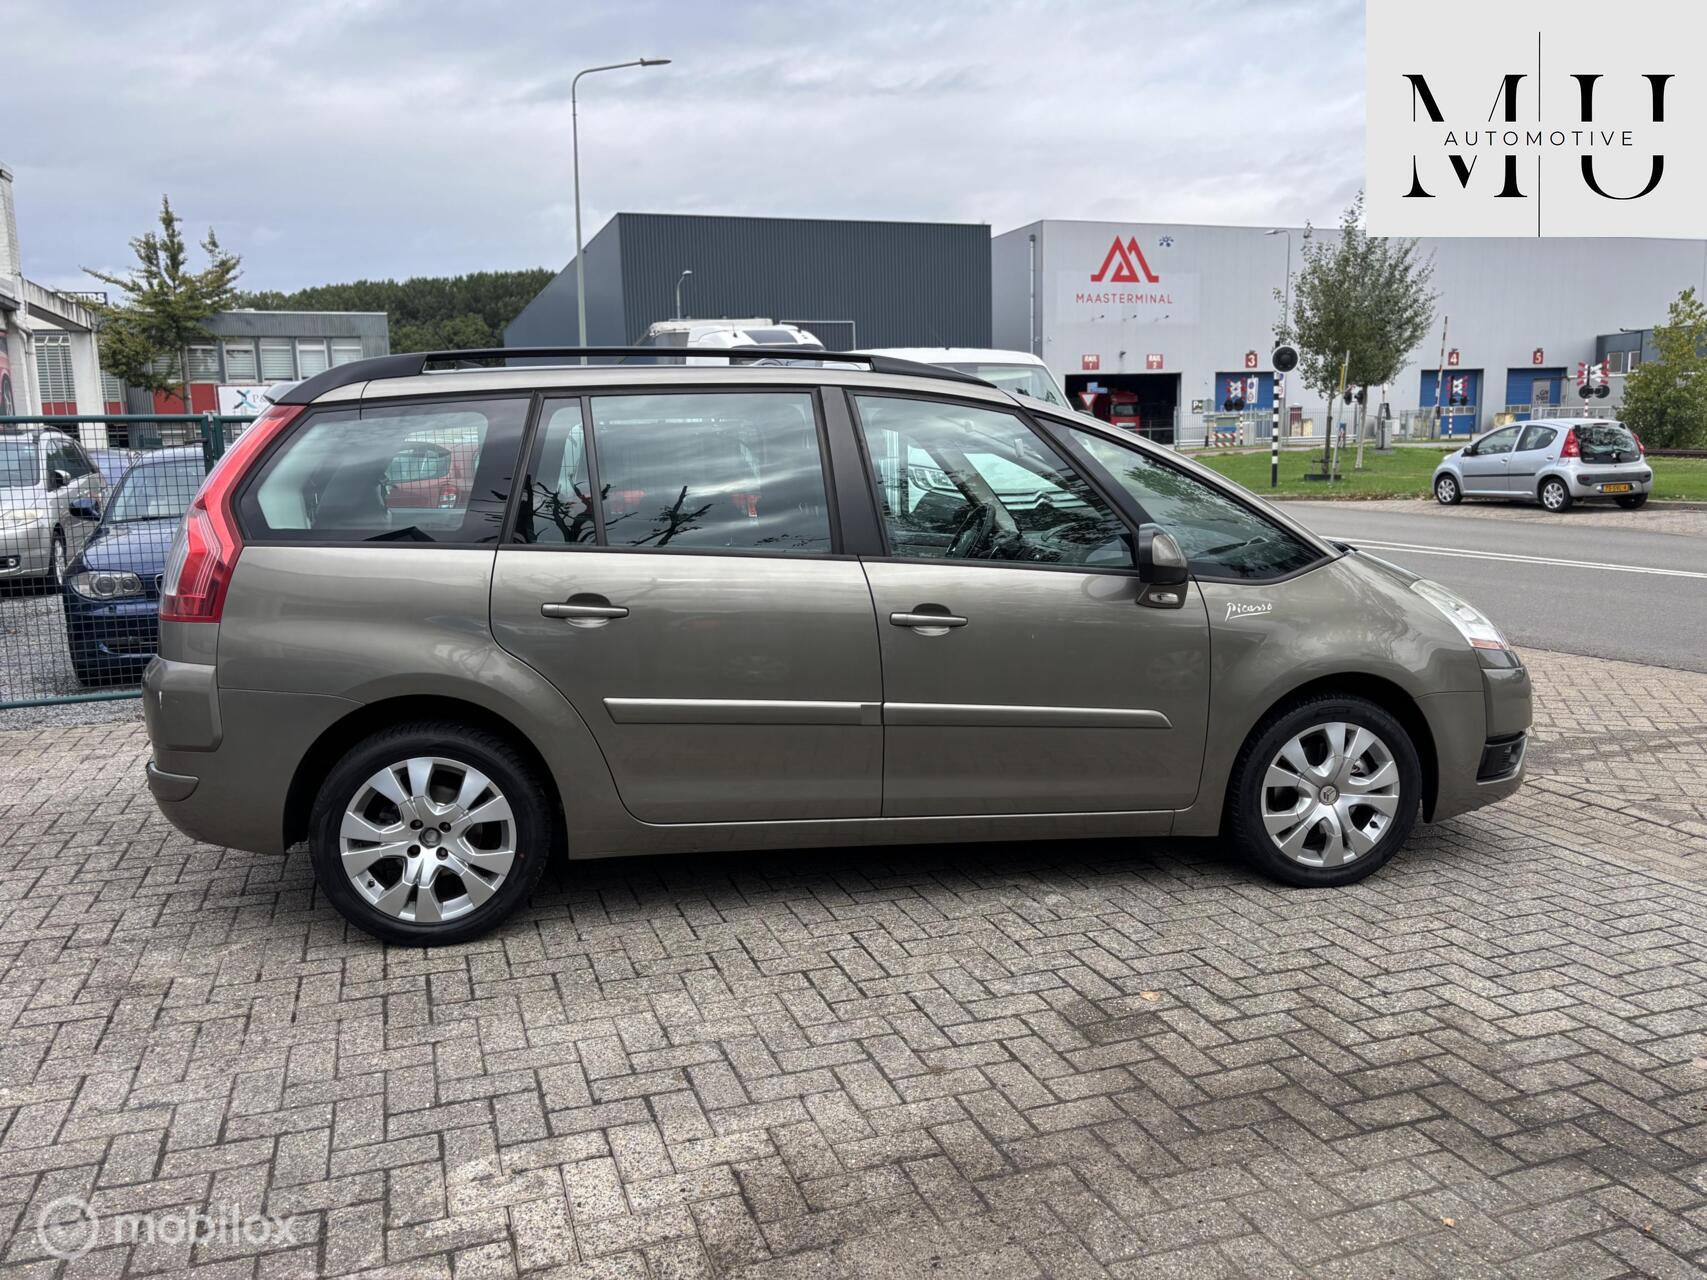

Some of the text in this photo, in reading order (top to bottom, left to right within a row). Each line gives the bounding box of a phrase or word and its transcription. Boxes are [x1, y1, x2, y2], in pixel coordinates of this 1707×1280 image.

[1076, 293, 1173, 304] MAASTERMINAL
[1247, 354, 1256, 367] 3
[1450, 353, 1458, 364] 4
[1535, 352, 1542, 363] 5
